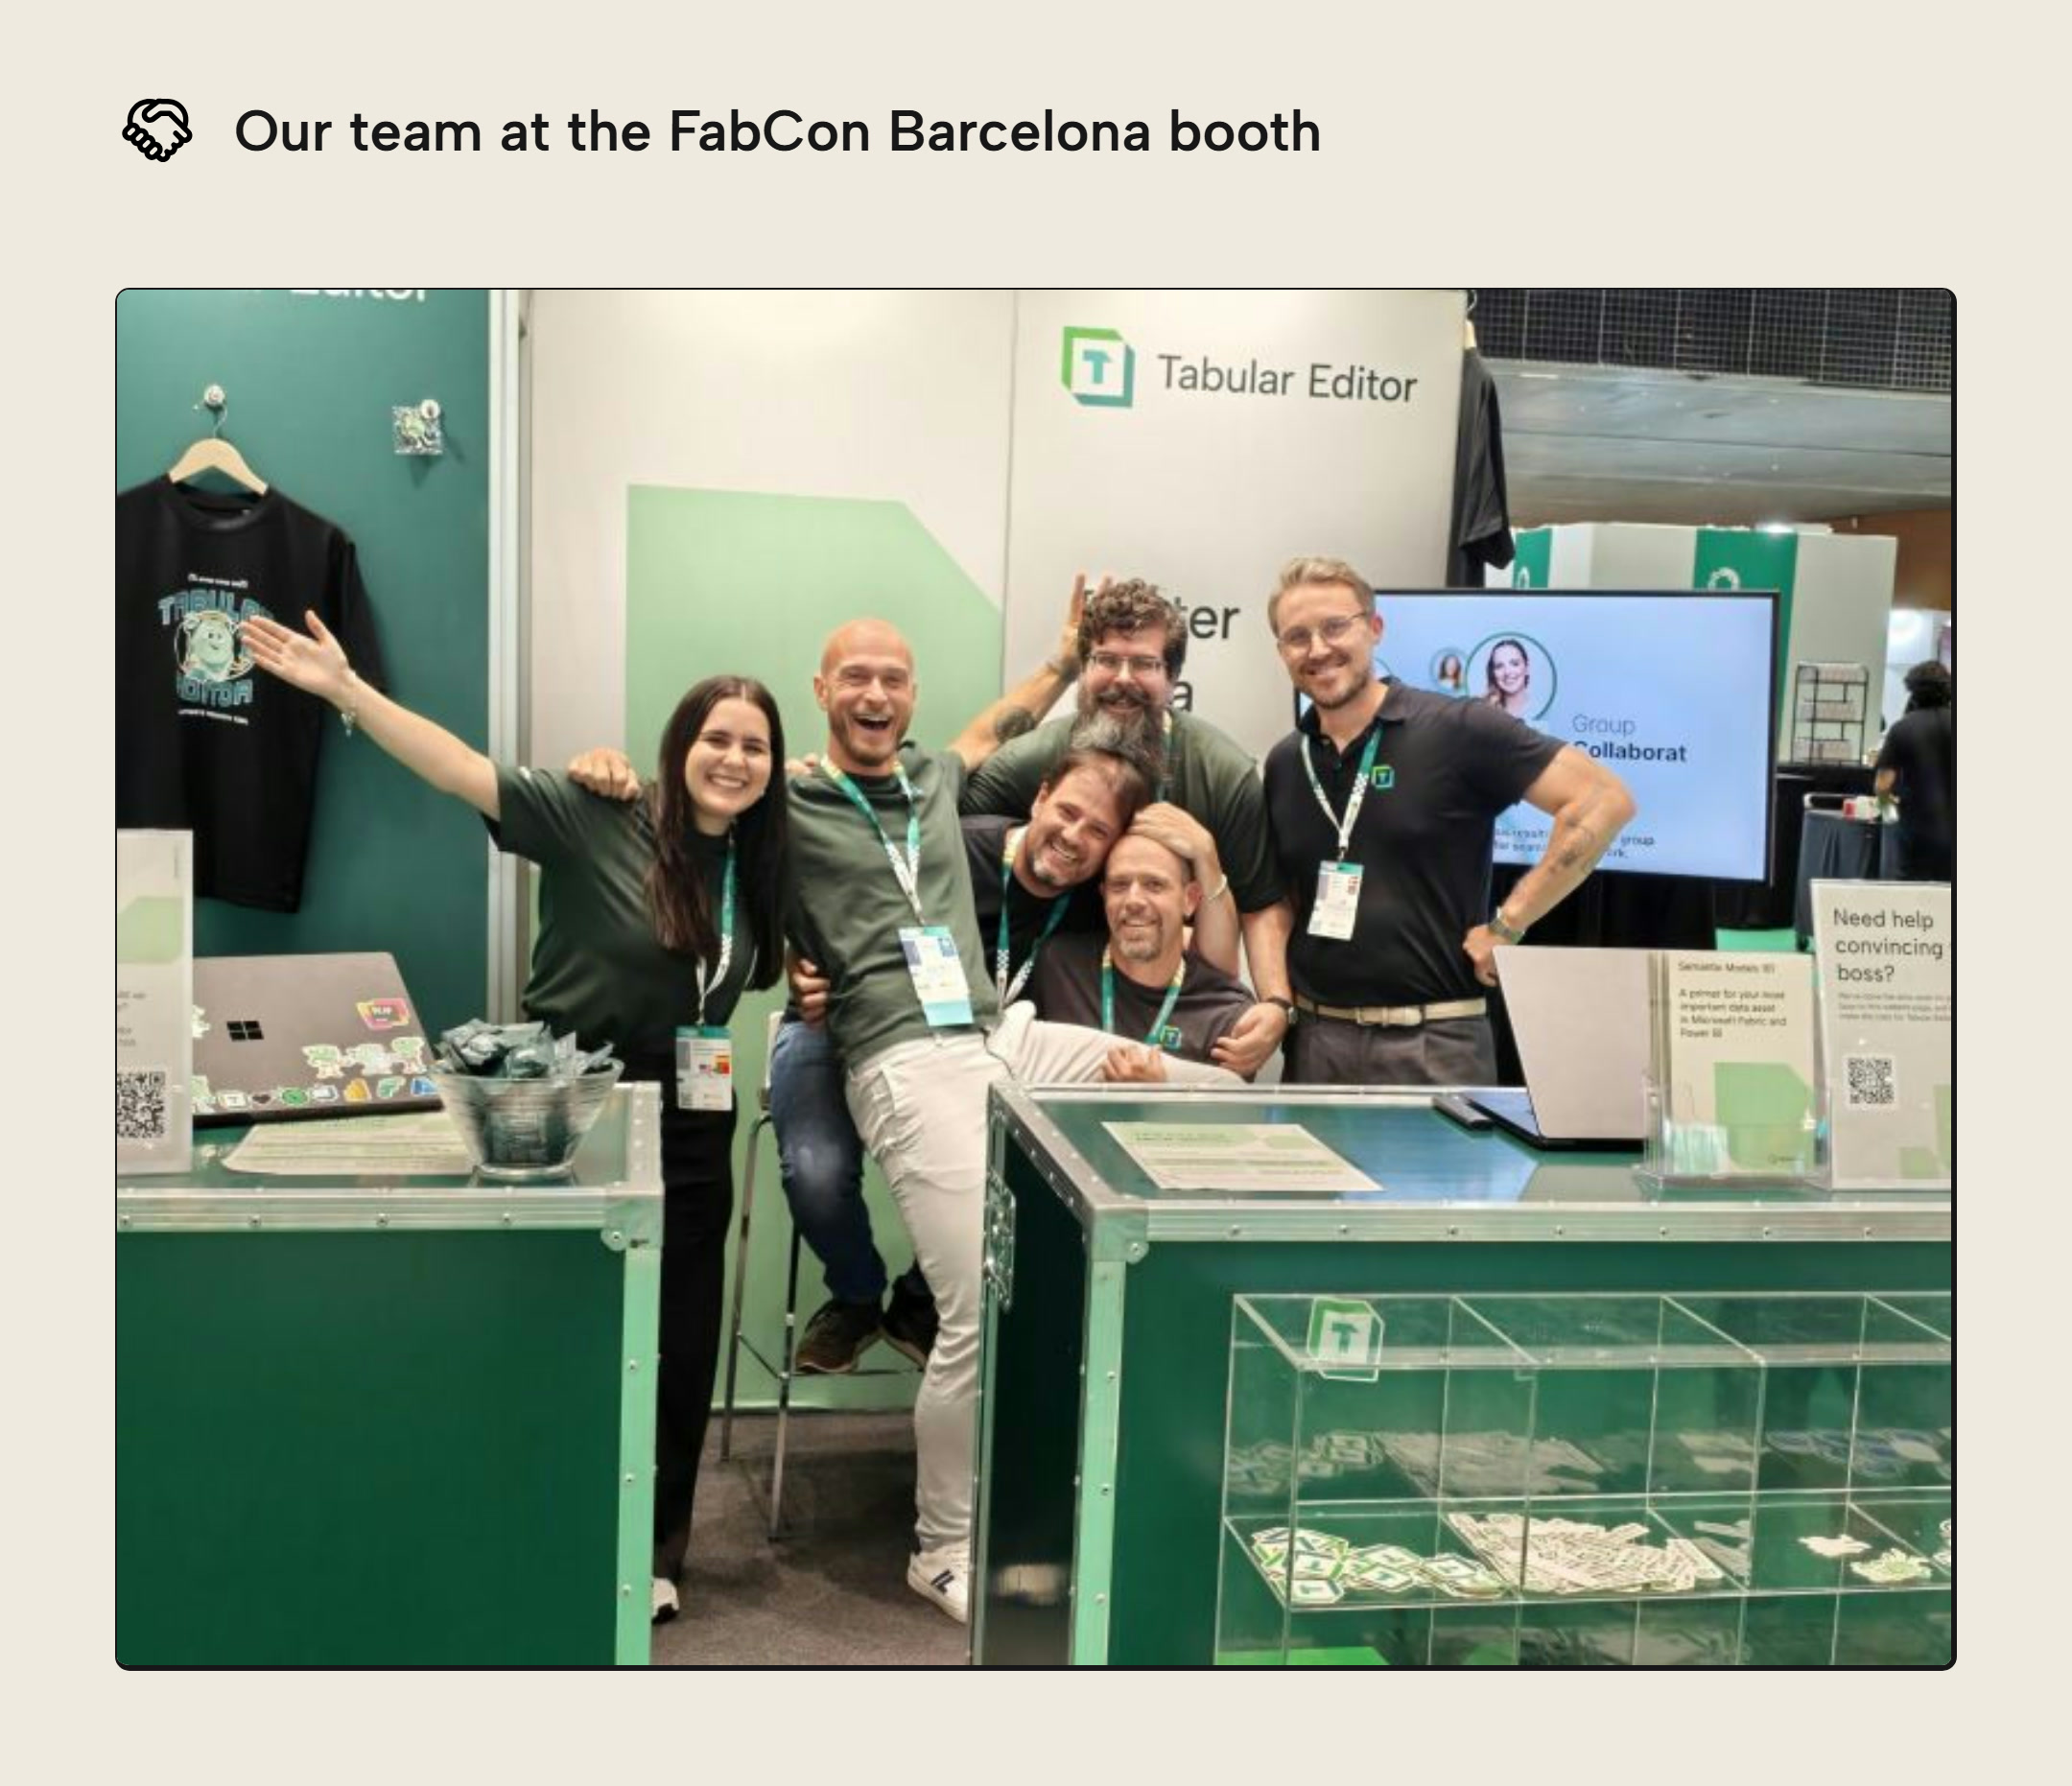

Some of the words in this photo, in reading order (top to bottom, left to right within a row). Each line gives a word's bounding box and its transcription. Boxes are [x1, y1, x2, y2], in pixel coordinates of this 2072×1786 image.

[1158, 354, 1295, 396] Tabular
[1308, 363, 1419, 403] Editor
[1571, 713, 1636, 739] Group
[1833, 907, 1886, 928] Need
[1892, 909, 1934, 932] help
[1835, 937, 1943, 961] convincing
[1837, 963, 1895, 983] boss?
